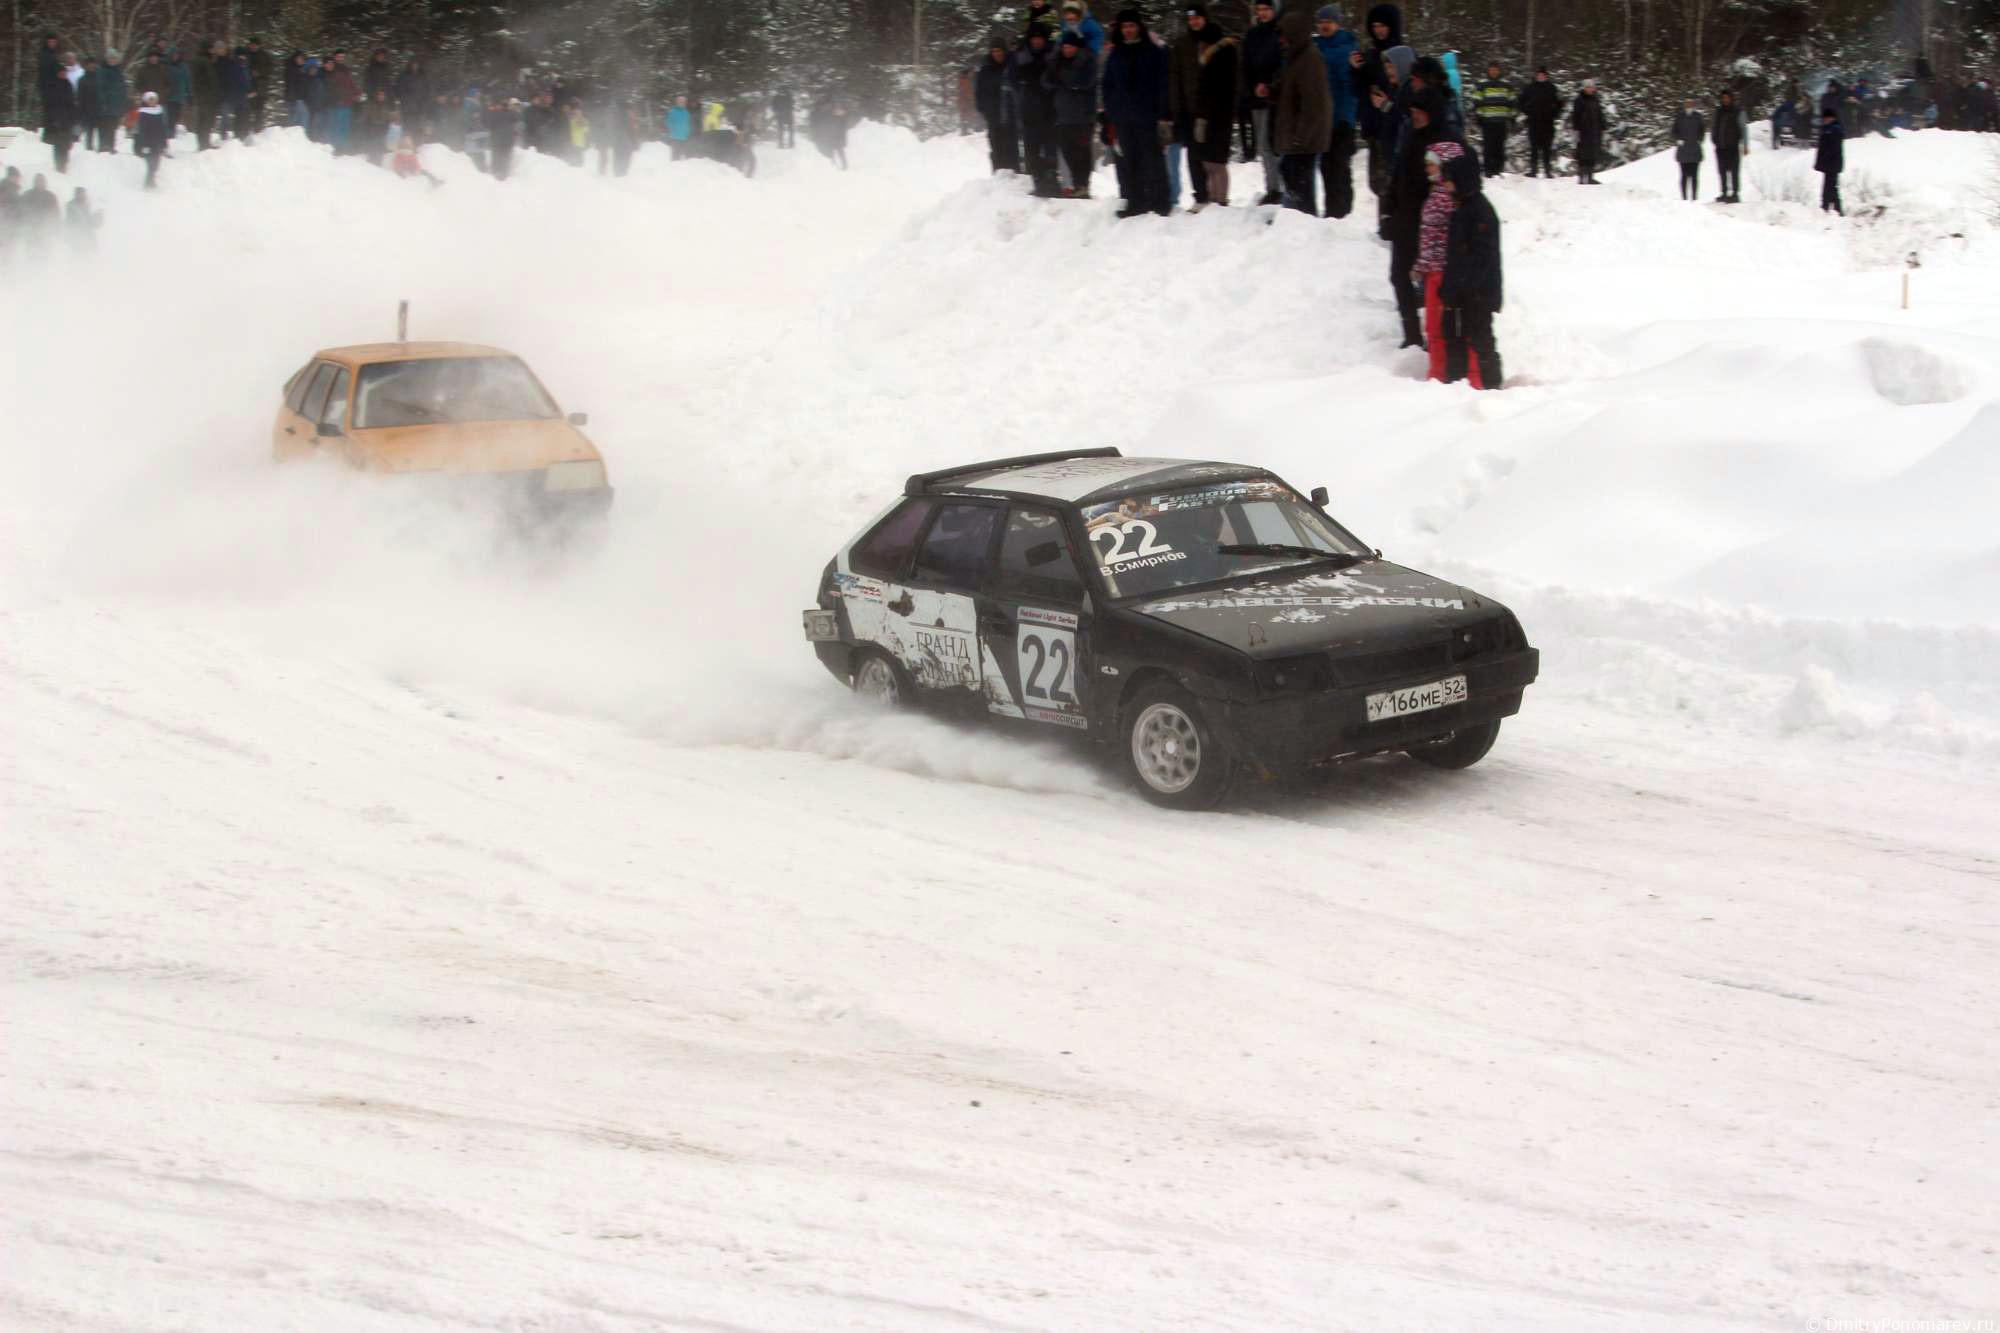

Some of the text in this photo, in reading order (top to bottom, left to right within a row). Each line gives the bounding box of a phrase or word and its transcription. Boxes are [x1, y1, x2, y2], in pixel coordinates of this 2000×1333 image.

[1089, 519, 1172, 566] 22
[1100, 551, 1187, 577] В.Смирнов
[916, 631, 971, 663] ГРАНД
[1022, 634, 1073, 703] 22
[1445, 679, 1461, 696] 52
